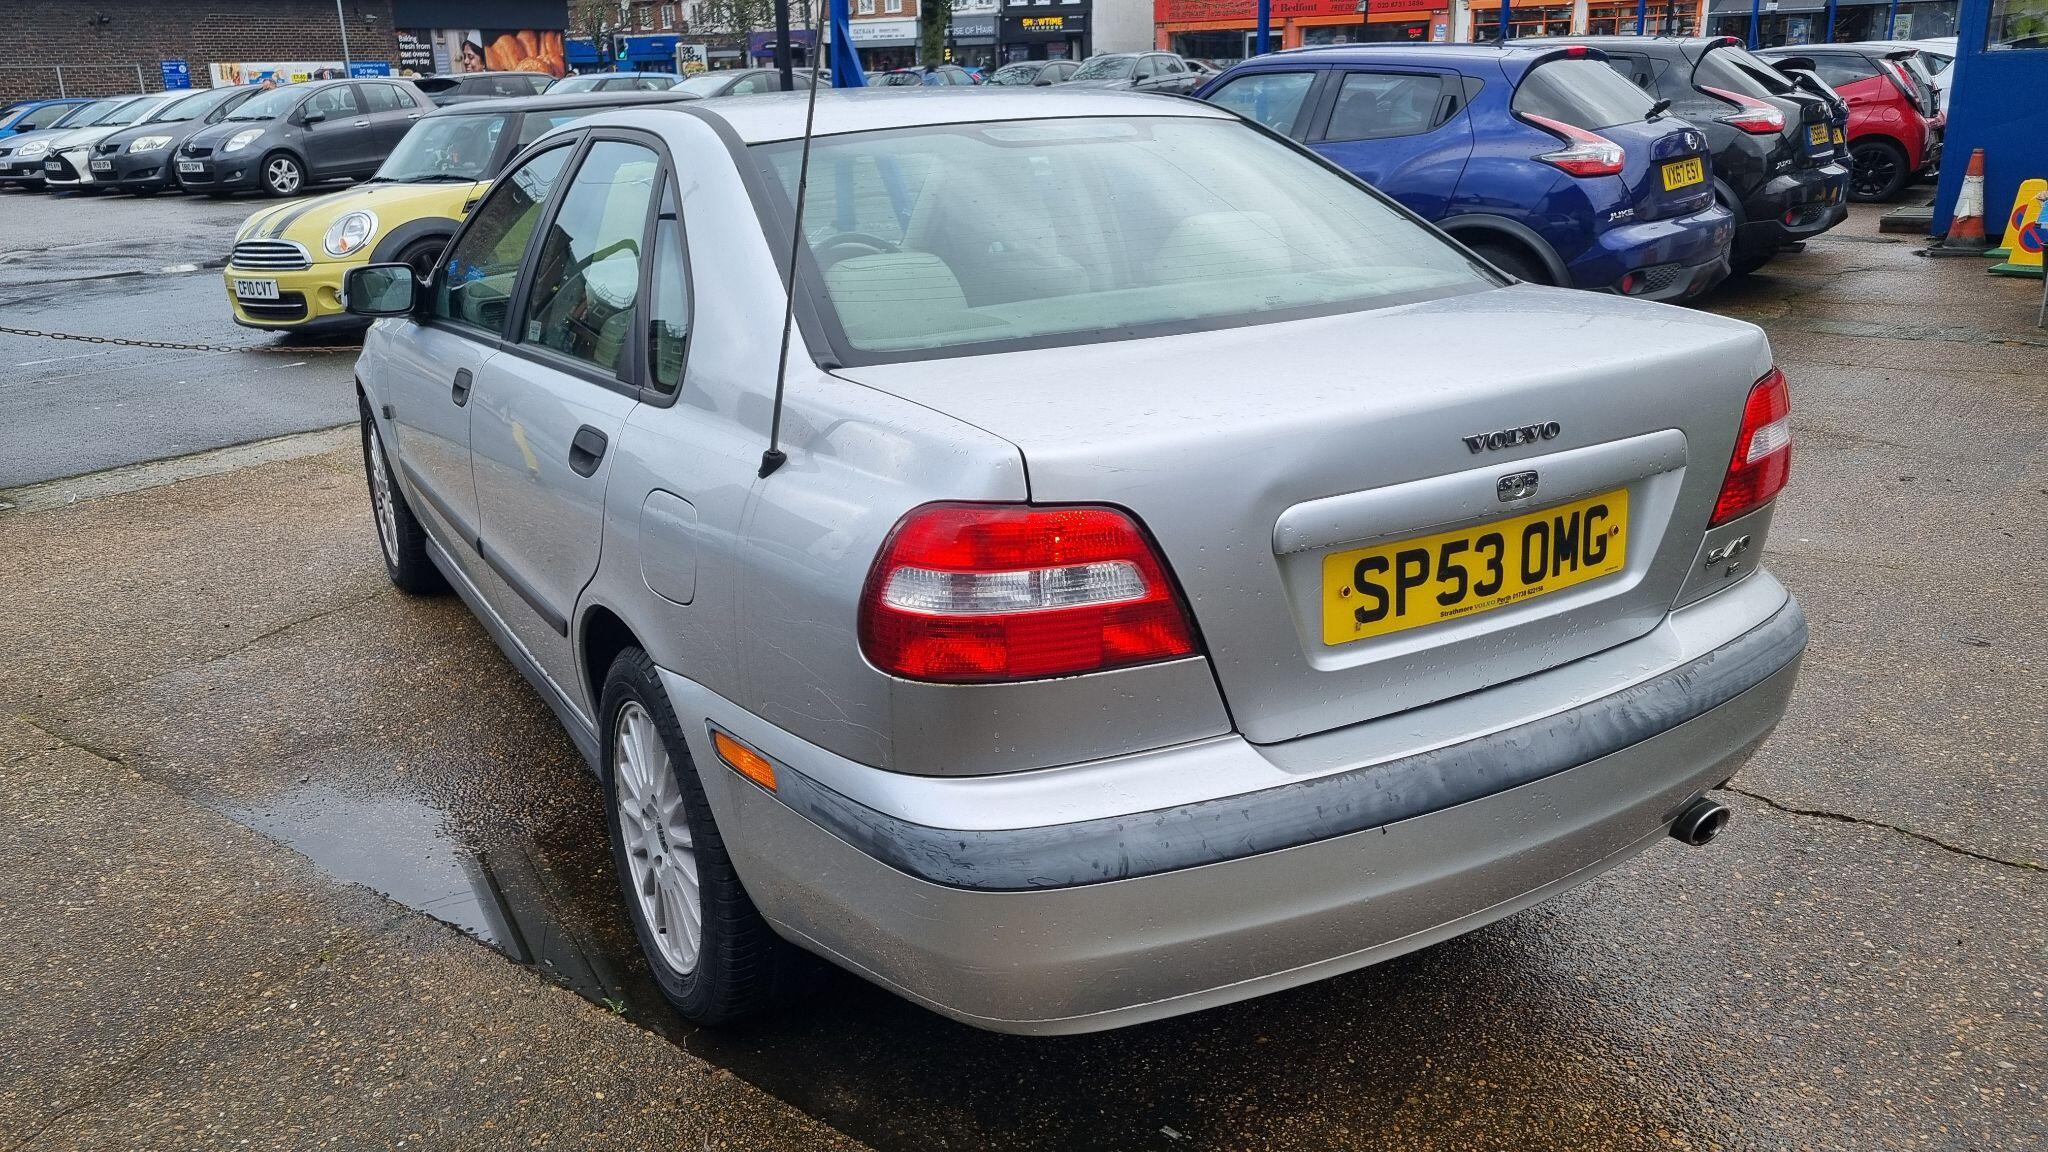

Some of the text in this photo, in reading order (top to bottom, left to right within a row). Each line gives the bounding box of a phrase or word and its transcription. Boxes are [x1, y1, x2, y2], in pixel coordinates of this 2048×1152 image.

[1281, 3, 1317, 12] Bedfont
[1022, 17, 1063, 27] SHOWTIME
[400, 42, 430, 50] fresh from
[682, 46, 694, 55] BIG
[402, 58, 431, 67] every day
[1665, 160, 1701, 186] VX67 ESY
[1608, 208, 1635, 222] JUKE
[238, 280, 272, 296] CF10 CVT
[1462, 421, 1560, 454] VOLVO
[1353, 503, 1609, 624] SP53 OMG
[1440, 605, 1474, 618] Strathmore
[1474, 600, 1496, 610] VOLVO
[1497, 595, 1511, 605] Perth
